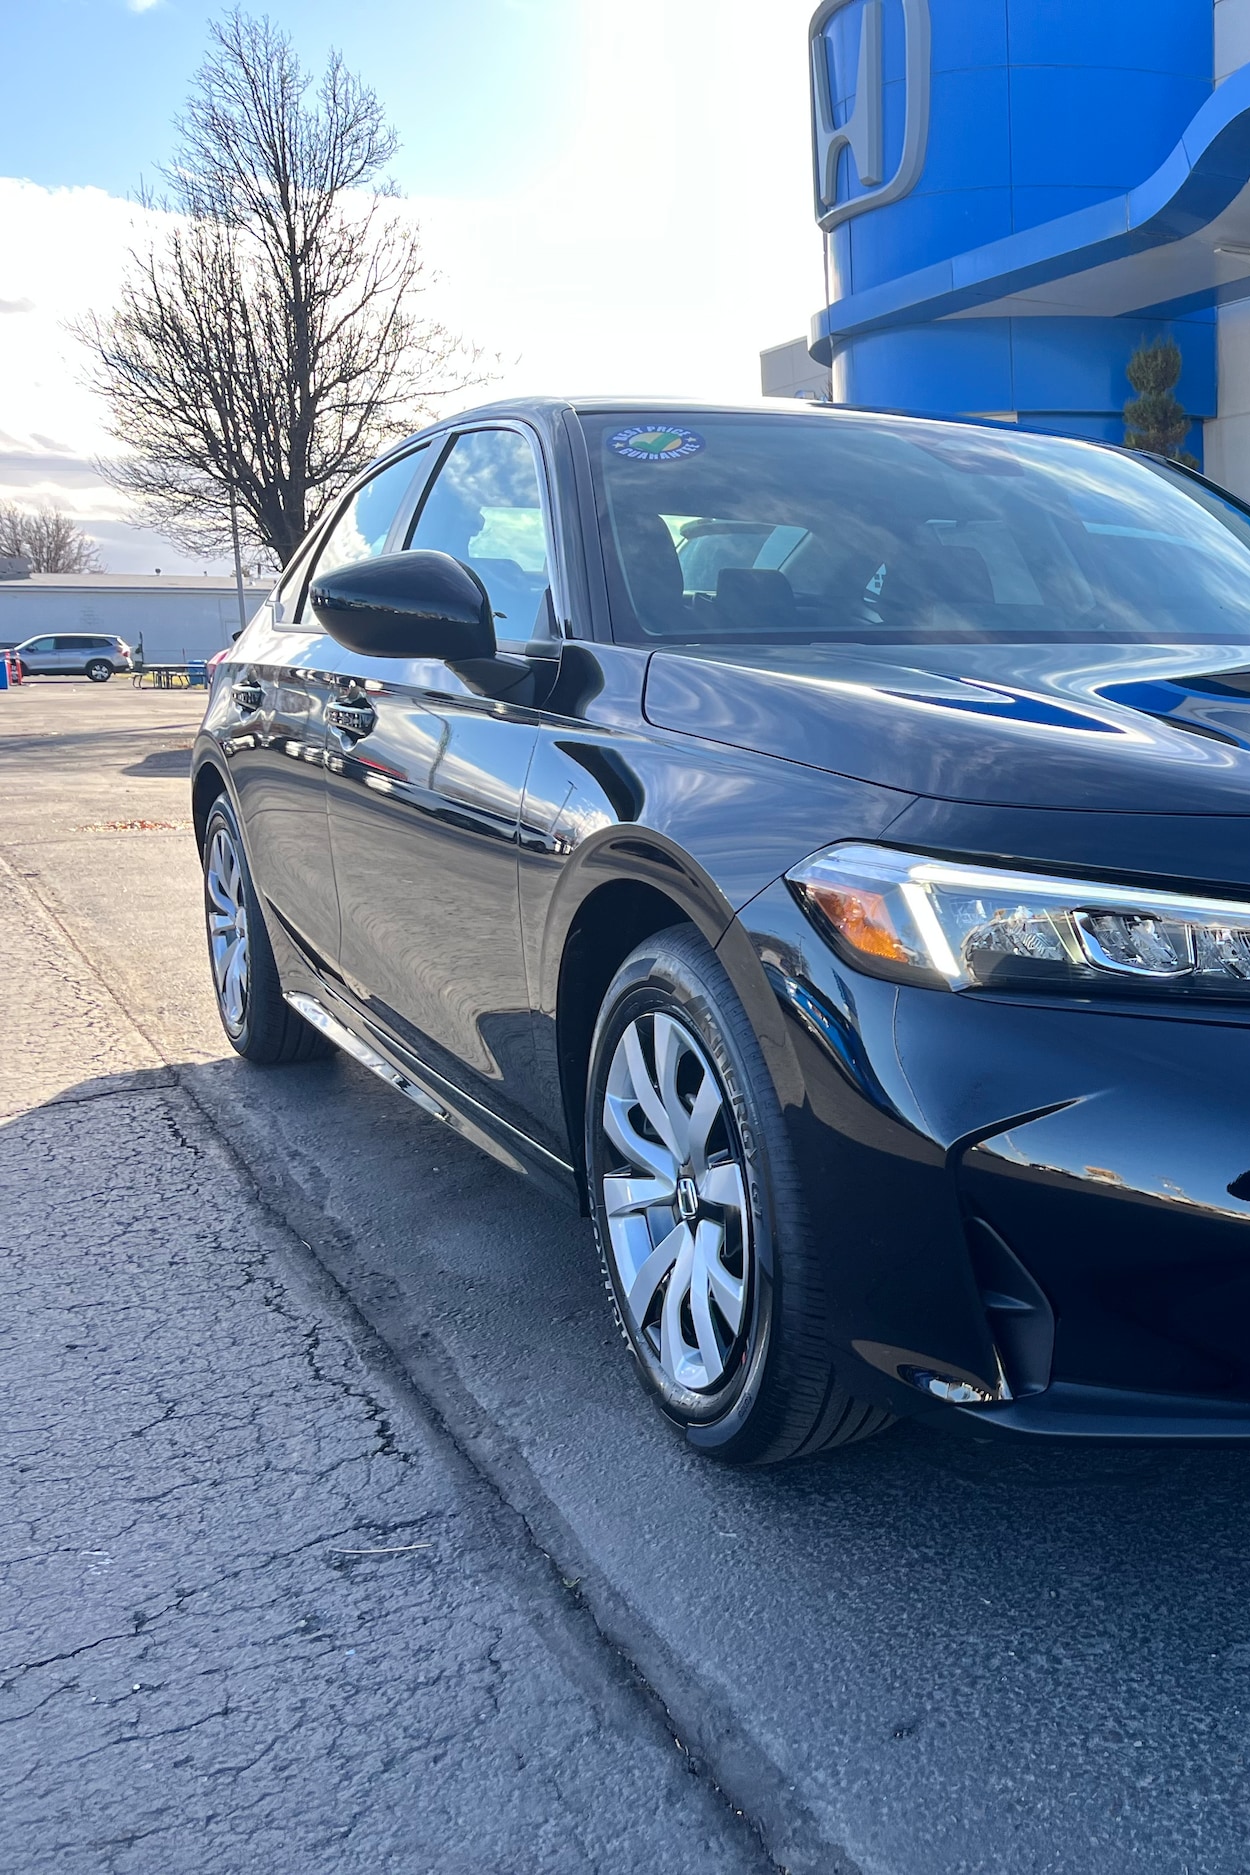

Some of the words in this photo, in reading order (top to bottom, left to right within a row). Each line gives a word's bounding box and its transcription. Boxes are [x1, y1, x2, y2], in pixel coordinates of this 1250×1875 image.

[612, 427, 643, 441] BEST
[646, 425, 691, 437] PRICE
[618, 443, 700, 460] GUARANTEE
